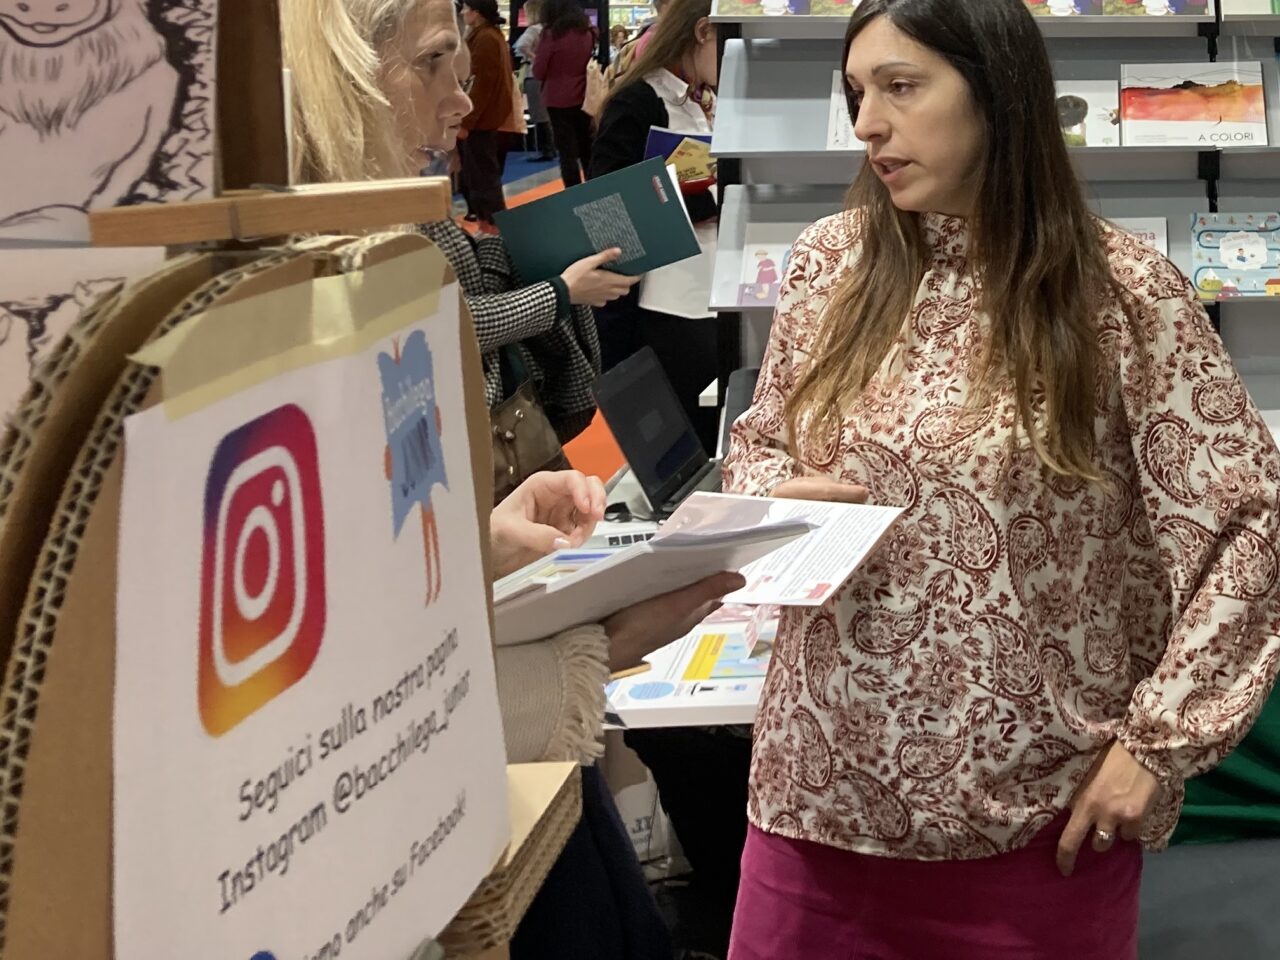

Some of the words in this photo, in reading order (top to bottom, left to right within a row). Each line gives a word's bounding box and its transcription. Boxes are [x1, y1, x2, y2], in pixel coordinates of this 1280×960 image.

[1209, 132, 1254, 142] COLORI
[217, 801, 327, 915] Instagram
[333, 670, 470, 814] @bacchilega_junior
[239, 733, 313, 822] Seguici
[318, 702, 367, 760] sulla
[373, 663, 424, 723] nostra
[426, 627, 458, 690] pagina
[345, 885, 389, 944] anche
[391, 862, 407, 896] su
